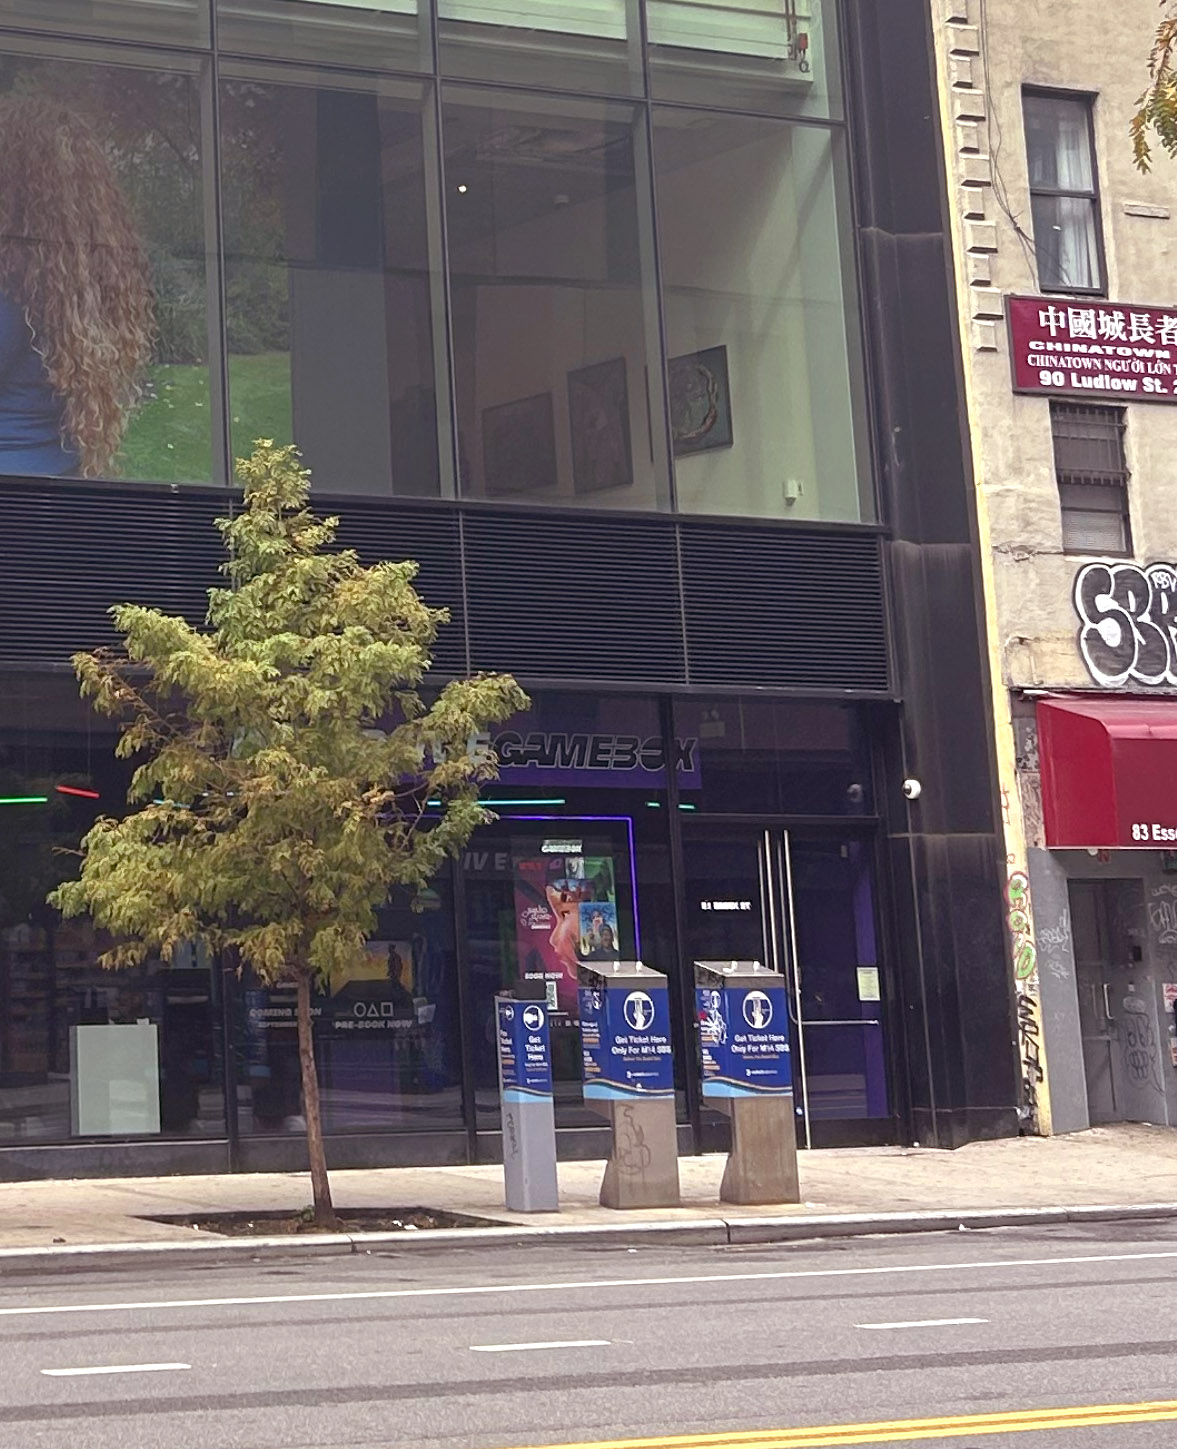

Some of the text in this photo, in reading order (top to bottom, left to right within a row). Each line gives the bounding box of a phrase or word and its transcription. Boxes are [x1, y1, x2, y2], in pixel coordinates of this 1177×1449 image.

[1028, 341, 1171, 359] CHINATOWN
[1027, 354, 1102, 370] CHINATOWN
[1039, 370, 1168, 394] 90 Ludlow St.
[491, 731, 699, 772] GAMEBOX
[1132, 823, 1177, 841] 83 Ess
[335, 1020, 413, 1029] PRE-BOOK NOW
[528, 1035, 542, 1044] Get
[615, 1036, 628, 1044] Get
[734, 1034, 785, 1042] Get Ticket Here
[525, 1044, 546, 1053] Ticket
[611, 1046, 627, 1055] Only
[628, 1046, 640, 1054] For
[731, 1044, 746, 1053] Only
[747, 1044, 759, 1052] For
